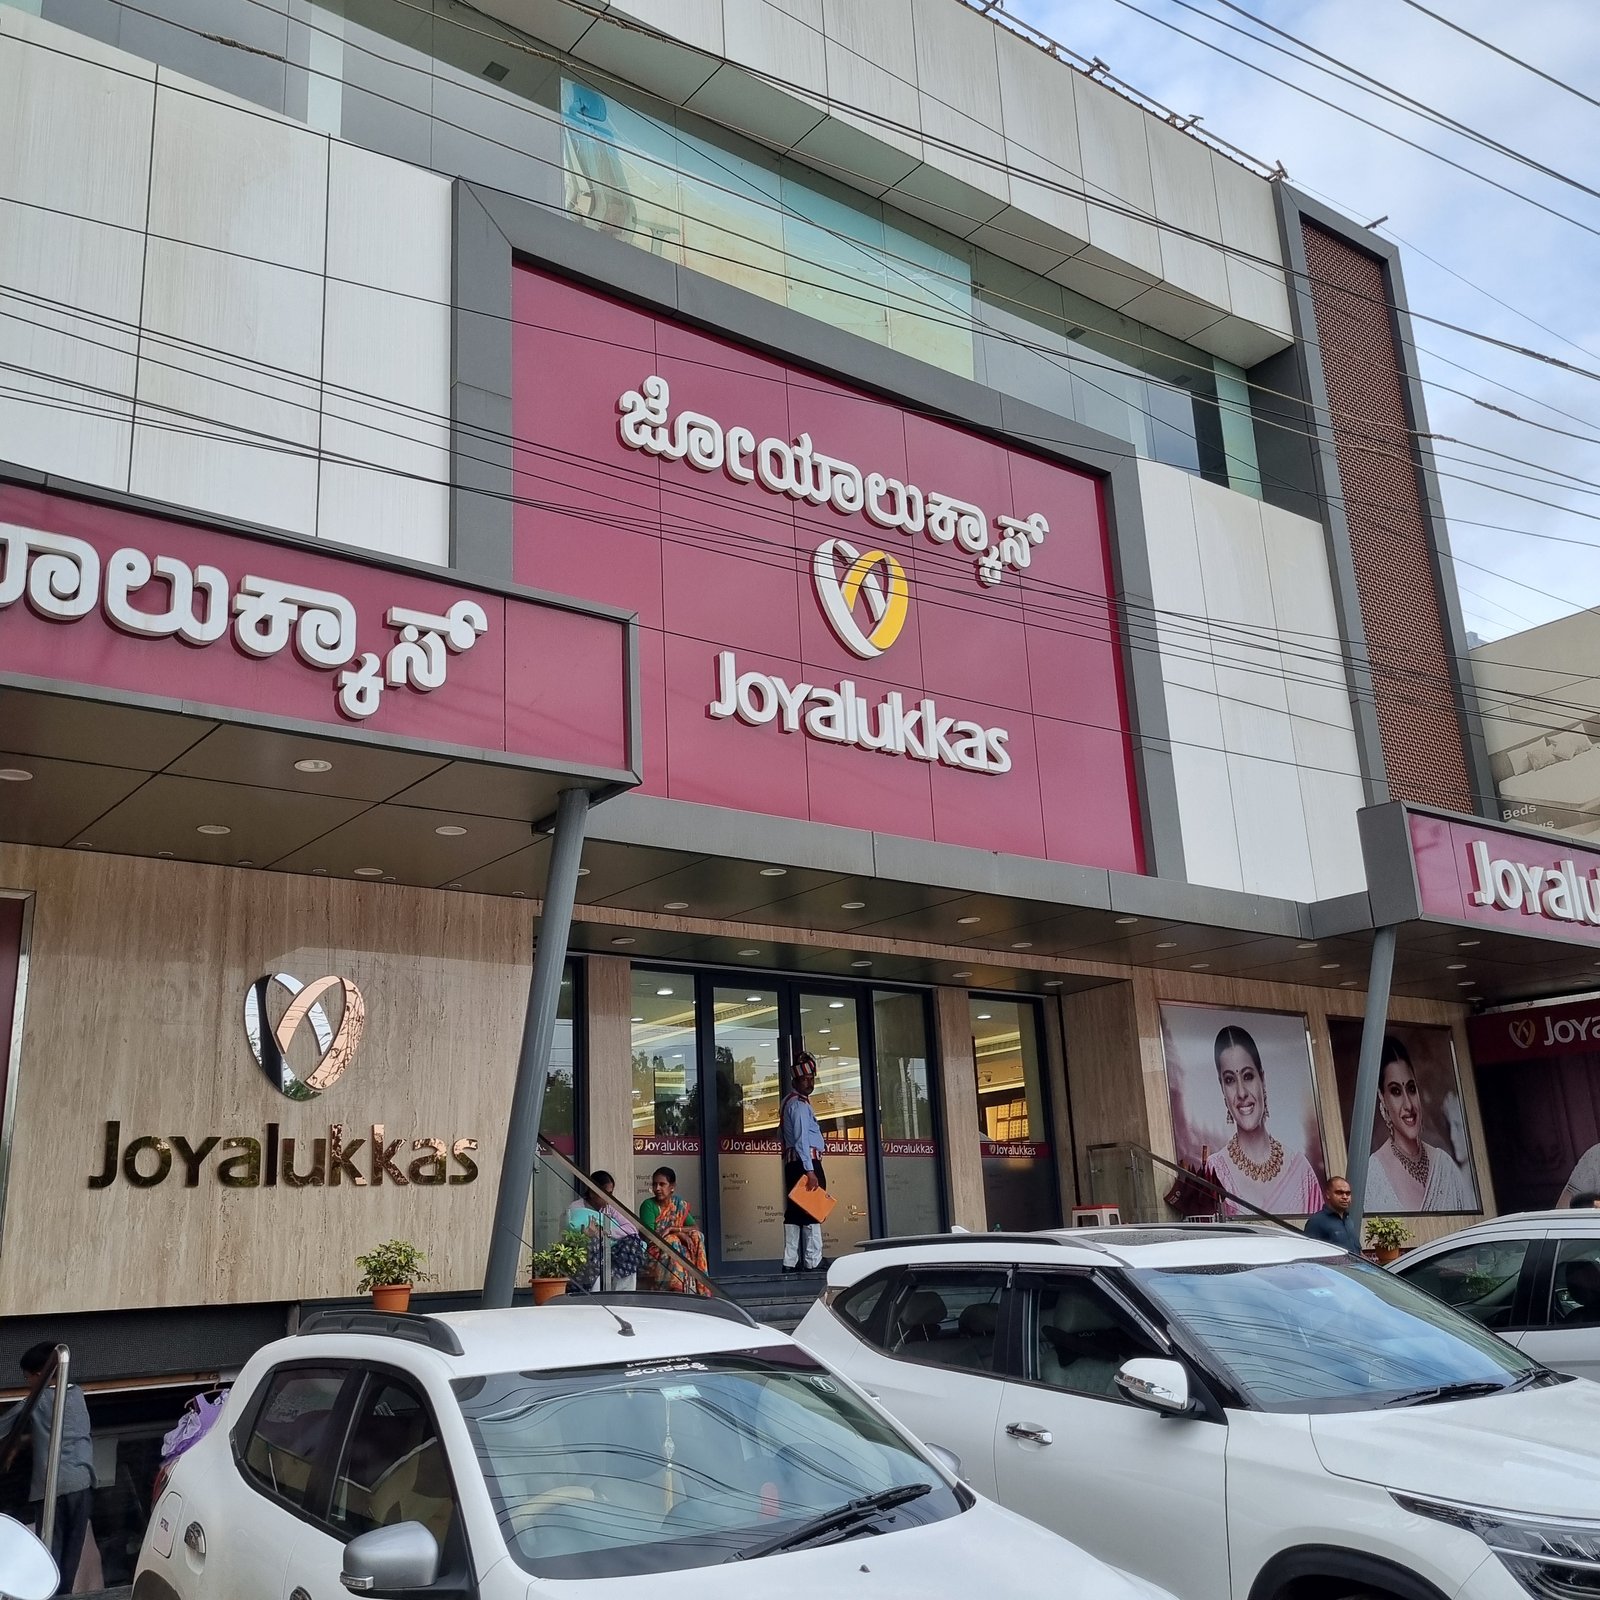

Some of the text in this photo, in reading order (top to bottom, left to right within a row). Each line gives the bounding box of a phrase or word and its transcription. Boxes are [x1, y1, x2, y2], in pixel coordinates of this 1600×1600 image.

[709, 651, 1012, 775] Joyalukkas
[1503, 804, 1537, 820] Beds
[644, 1139, 699, 1152] Joyalukkas
[730, 1139, 782, 1151] Joyalukkas
[890, 1142, 934, 1154] Joyalukkas
[996, 1144, 1036, 1155] Joyalukkas
[88, 1121, 479, 1189] Joyalukkas
